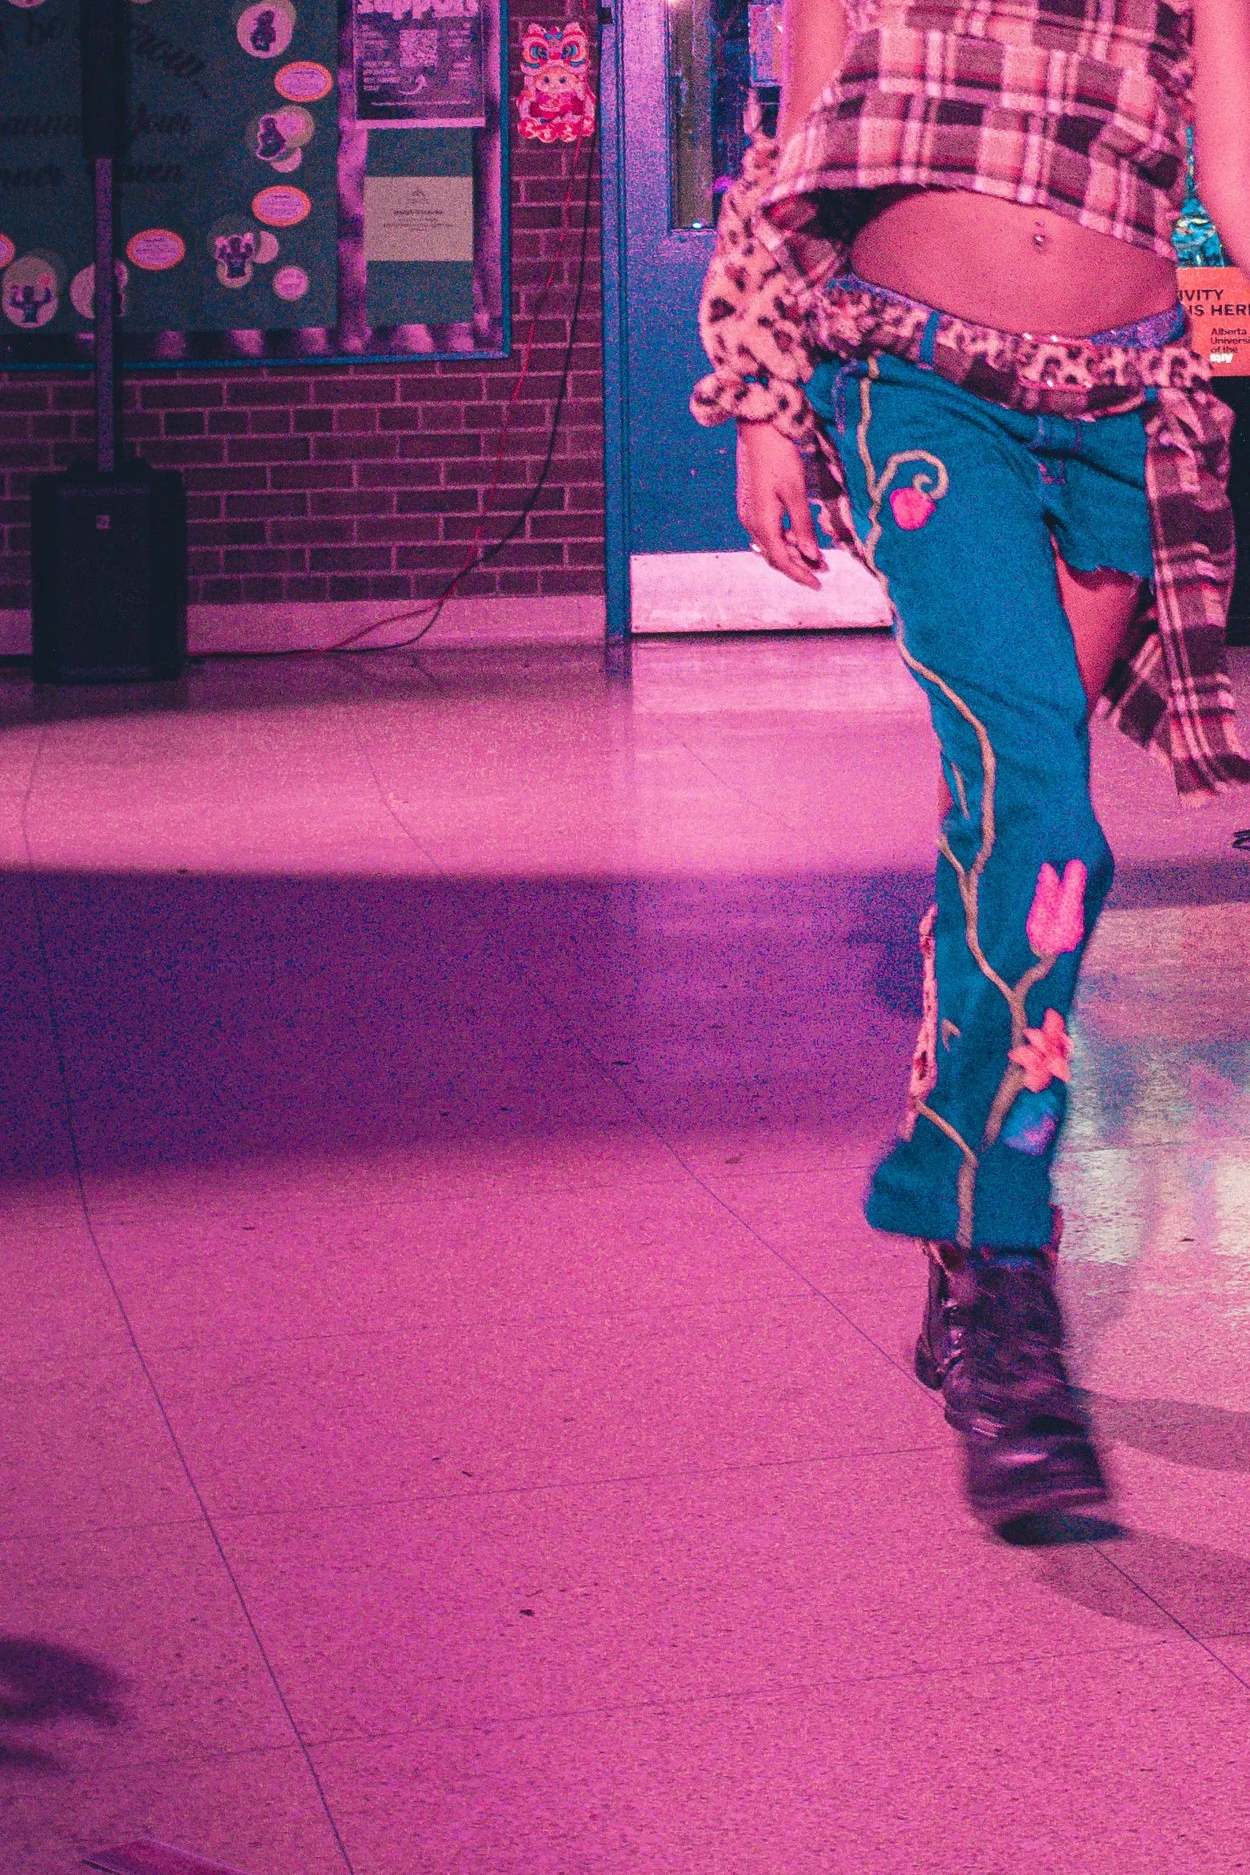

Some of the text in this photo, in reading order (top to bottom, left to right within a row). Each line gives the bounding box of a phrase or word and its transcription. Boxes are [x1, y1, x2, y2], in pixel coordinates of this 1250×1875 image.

[1178, 289, 1224, 302] IVITY
[1210, 327, 1248, 336] Alberta
[1222, 346, 1239, 354] the
